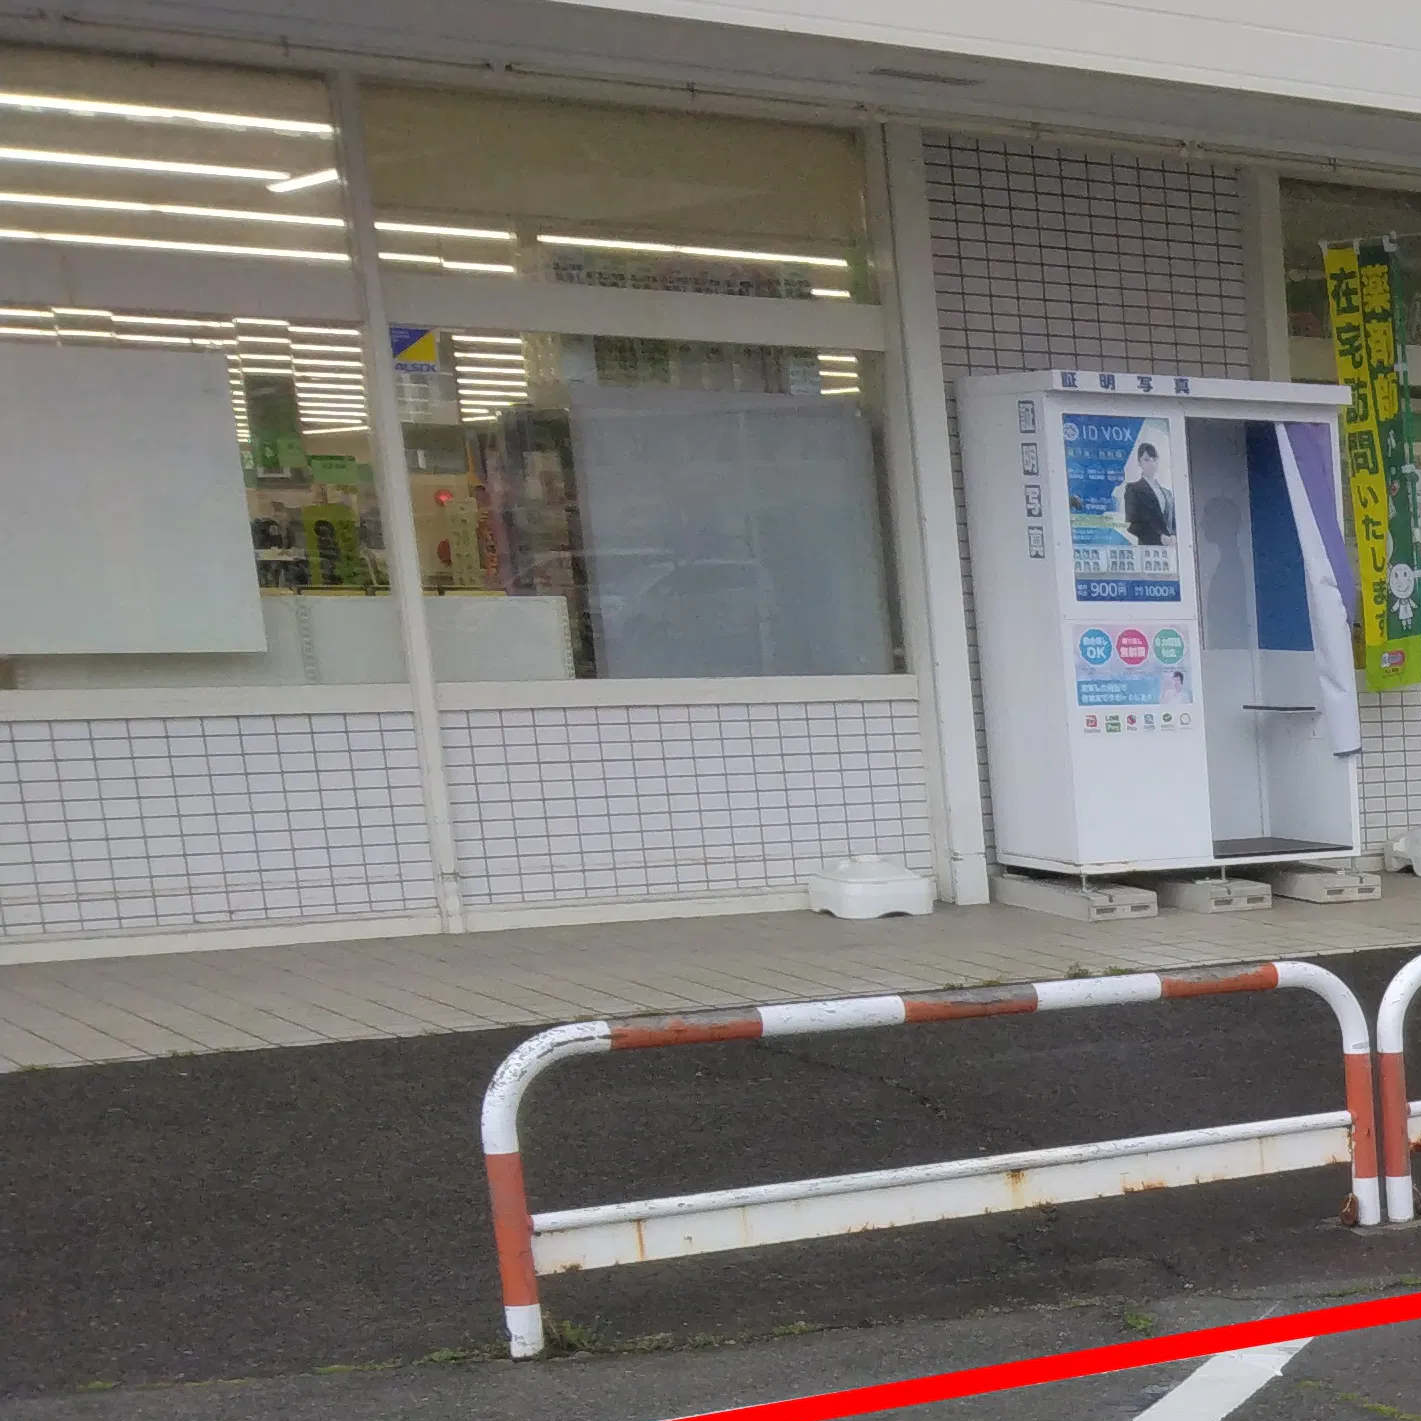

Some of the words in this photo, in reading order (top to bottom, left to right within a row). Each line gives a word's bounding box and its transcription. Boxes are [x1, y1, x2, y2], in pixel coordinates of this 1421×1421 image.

[1060, 371, 1191, 395] 証明写真
[1101, 426, 1134, 442] VOX
[1018, 400, 1045, 559] 証明写真
[1086, 646, 1106, 659] OK
